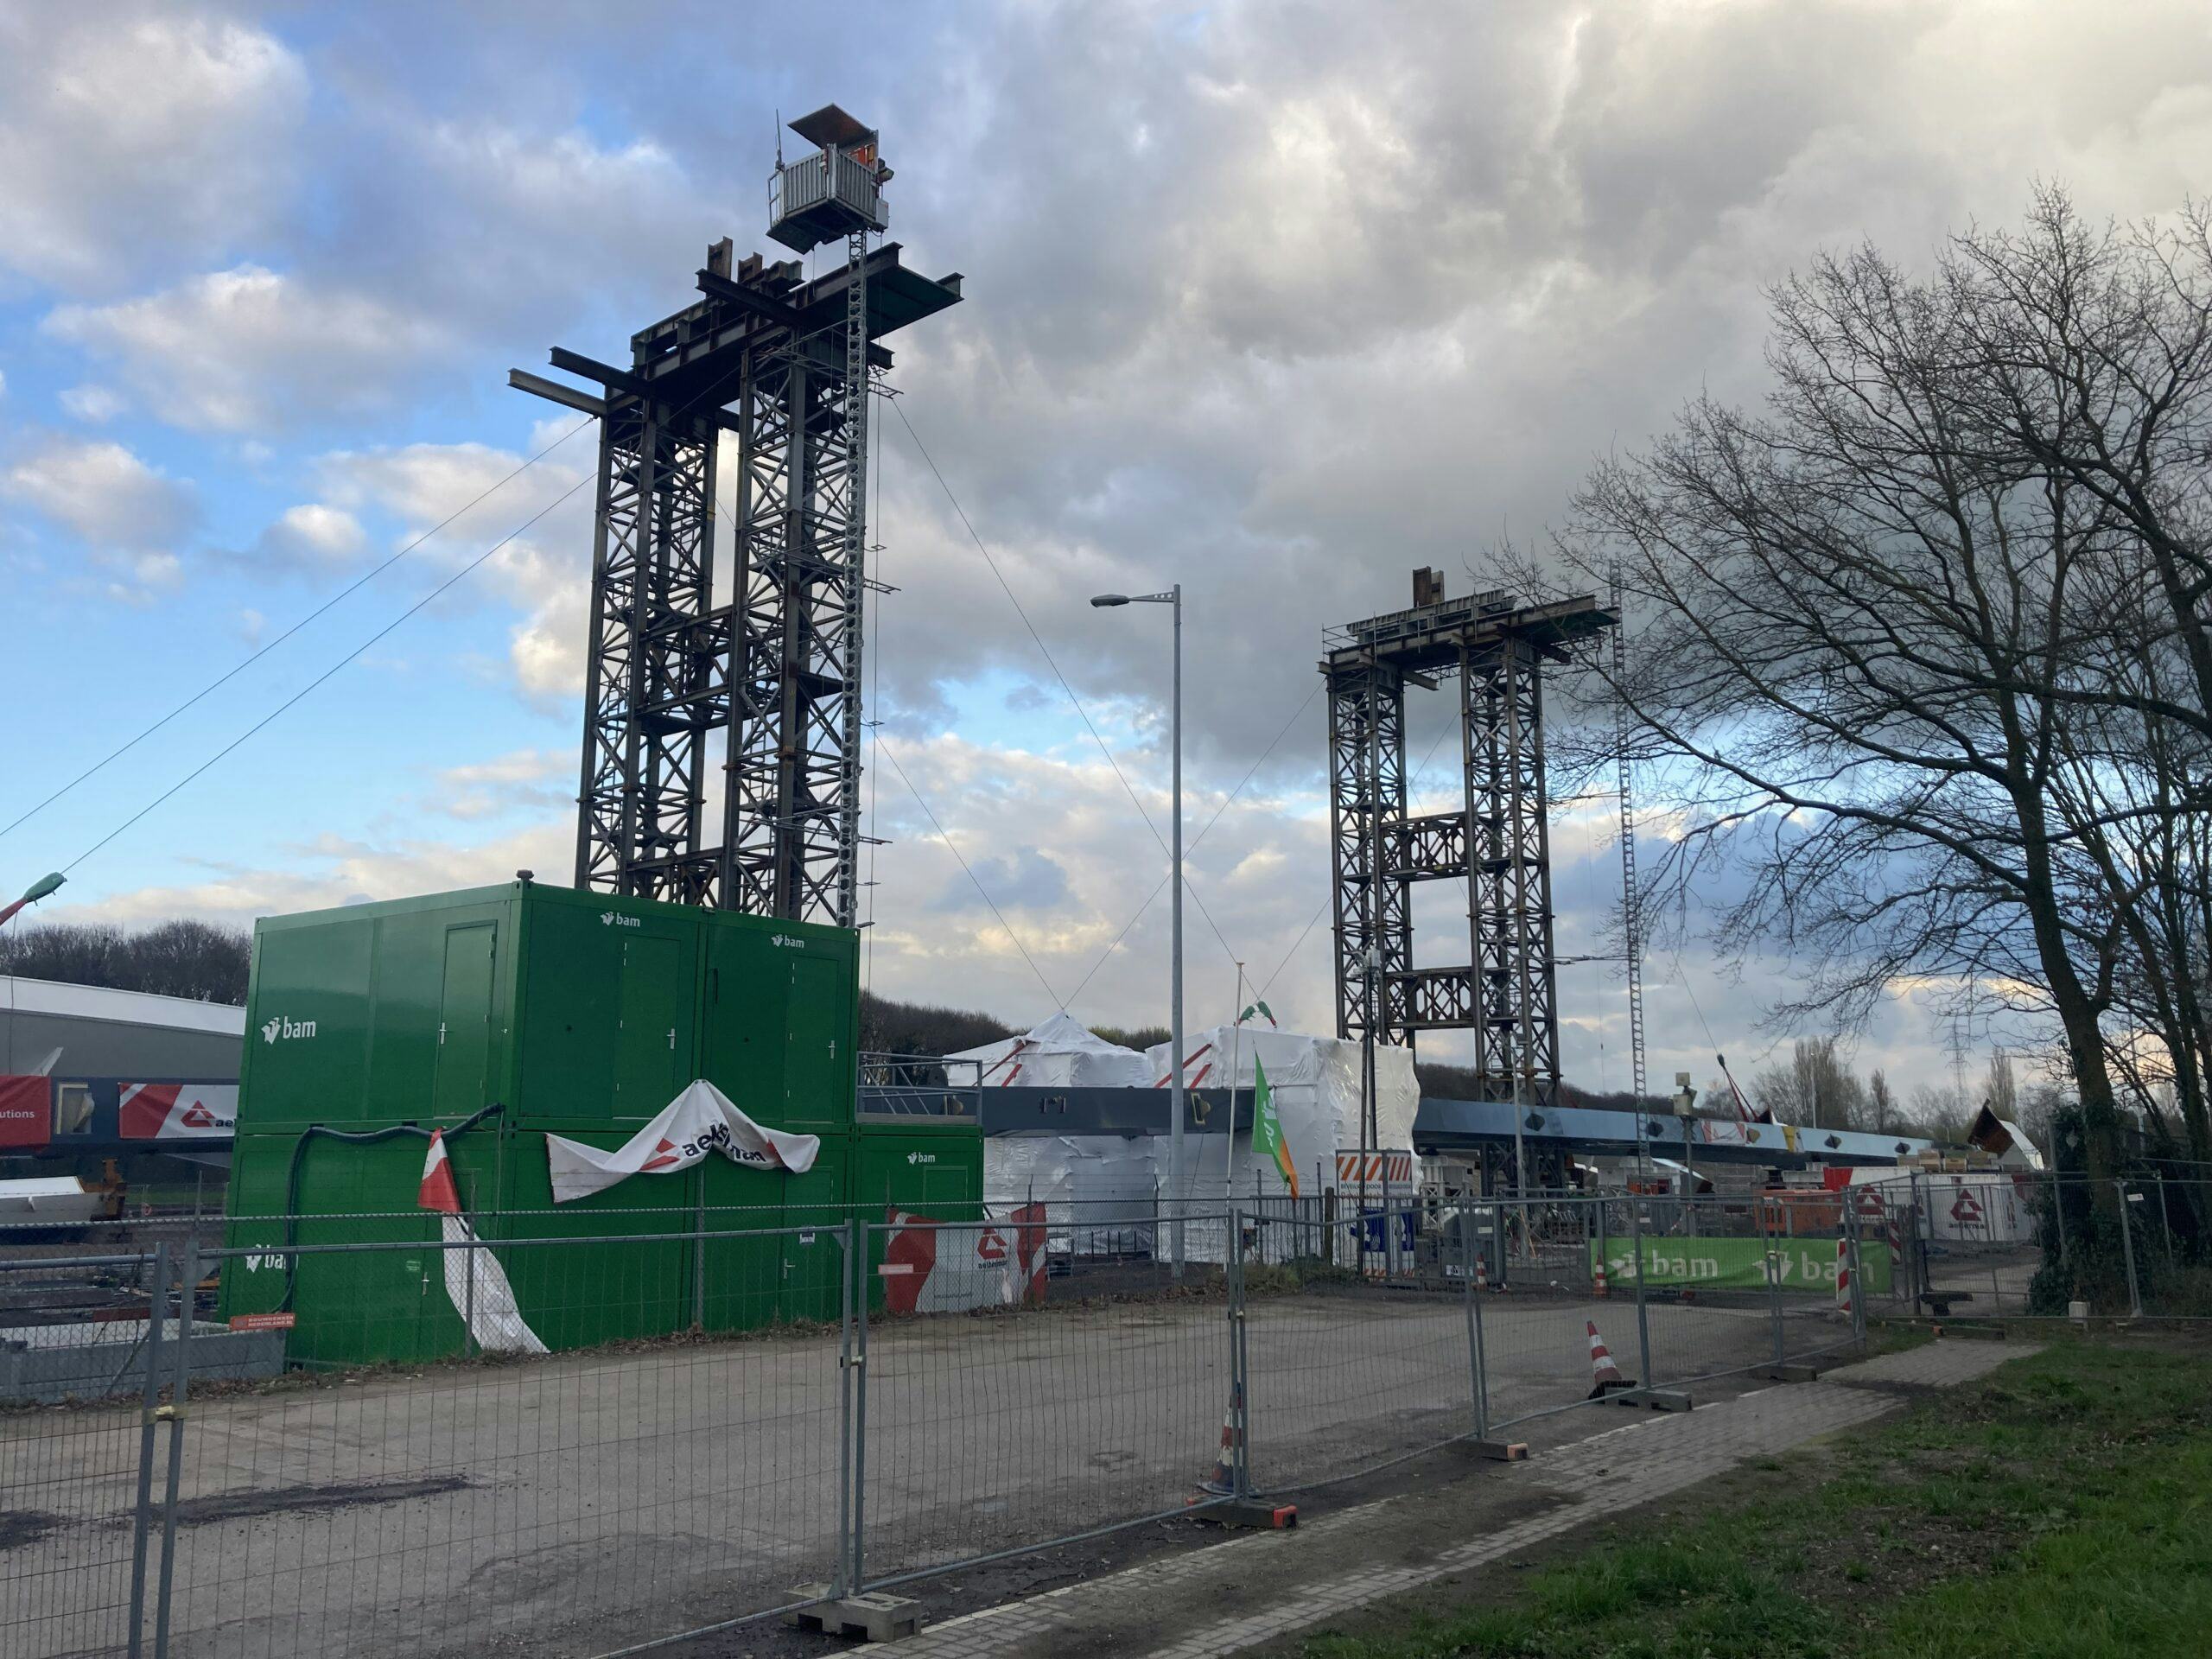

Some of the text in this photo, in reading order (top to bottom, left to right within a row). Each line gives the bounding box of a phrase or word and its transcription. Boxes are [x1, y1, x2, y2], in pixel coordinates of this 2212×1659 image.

[615, 912, 640, 927] bam
[785, 935, 804, 948] bam
[283, 1015, 316, 1039] bam
[0, 1109, 35, 1119] utions
[918, 1153, 936, 1163] bam
[1652, 1249, 1718, 1277] bam
